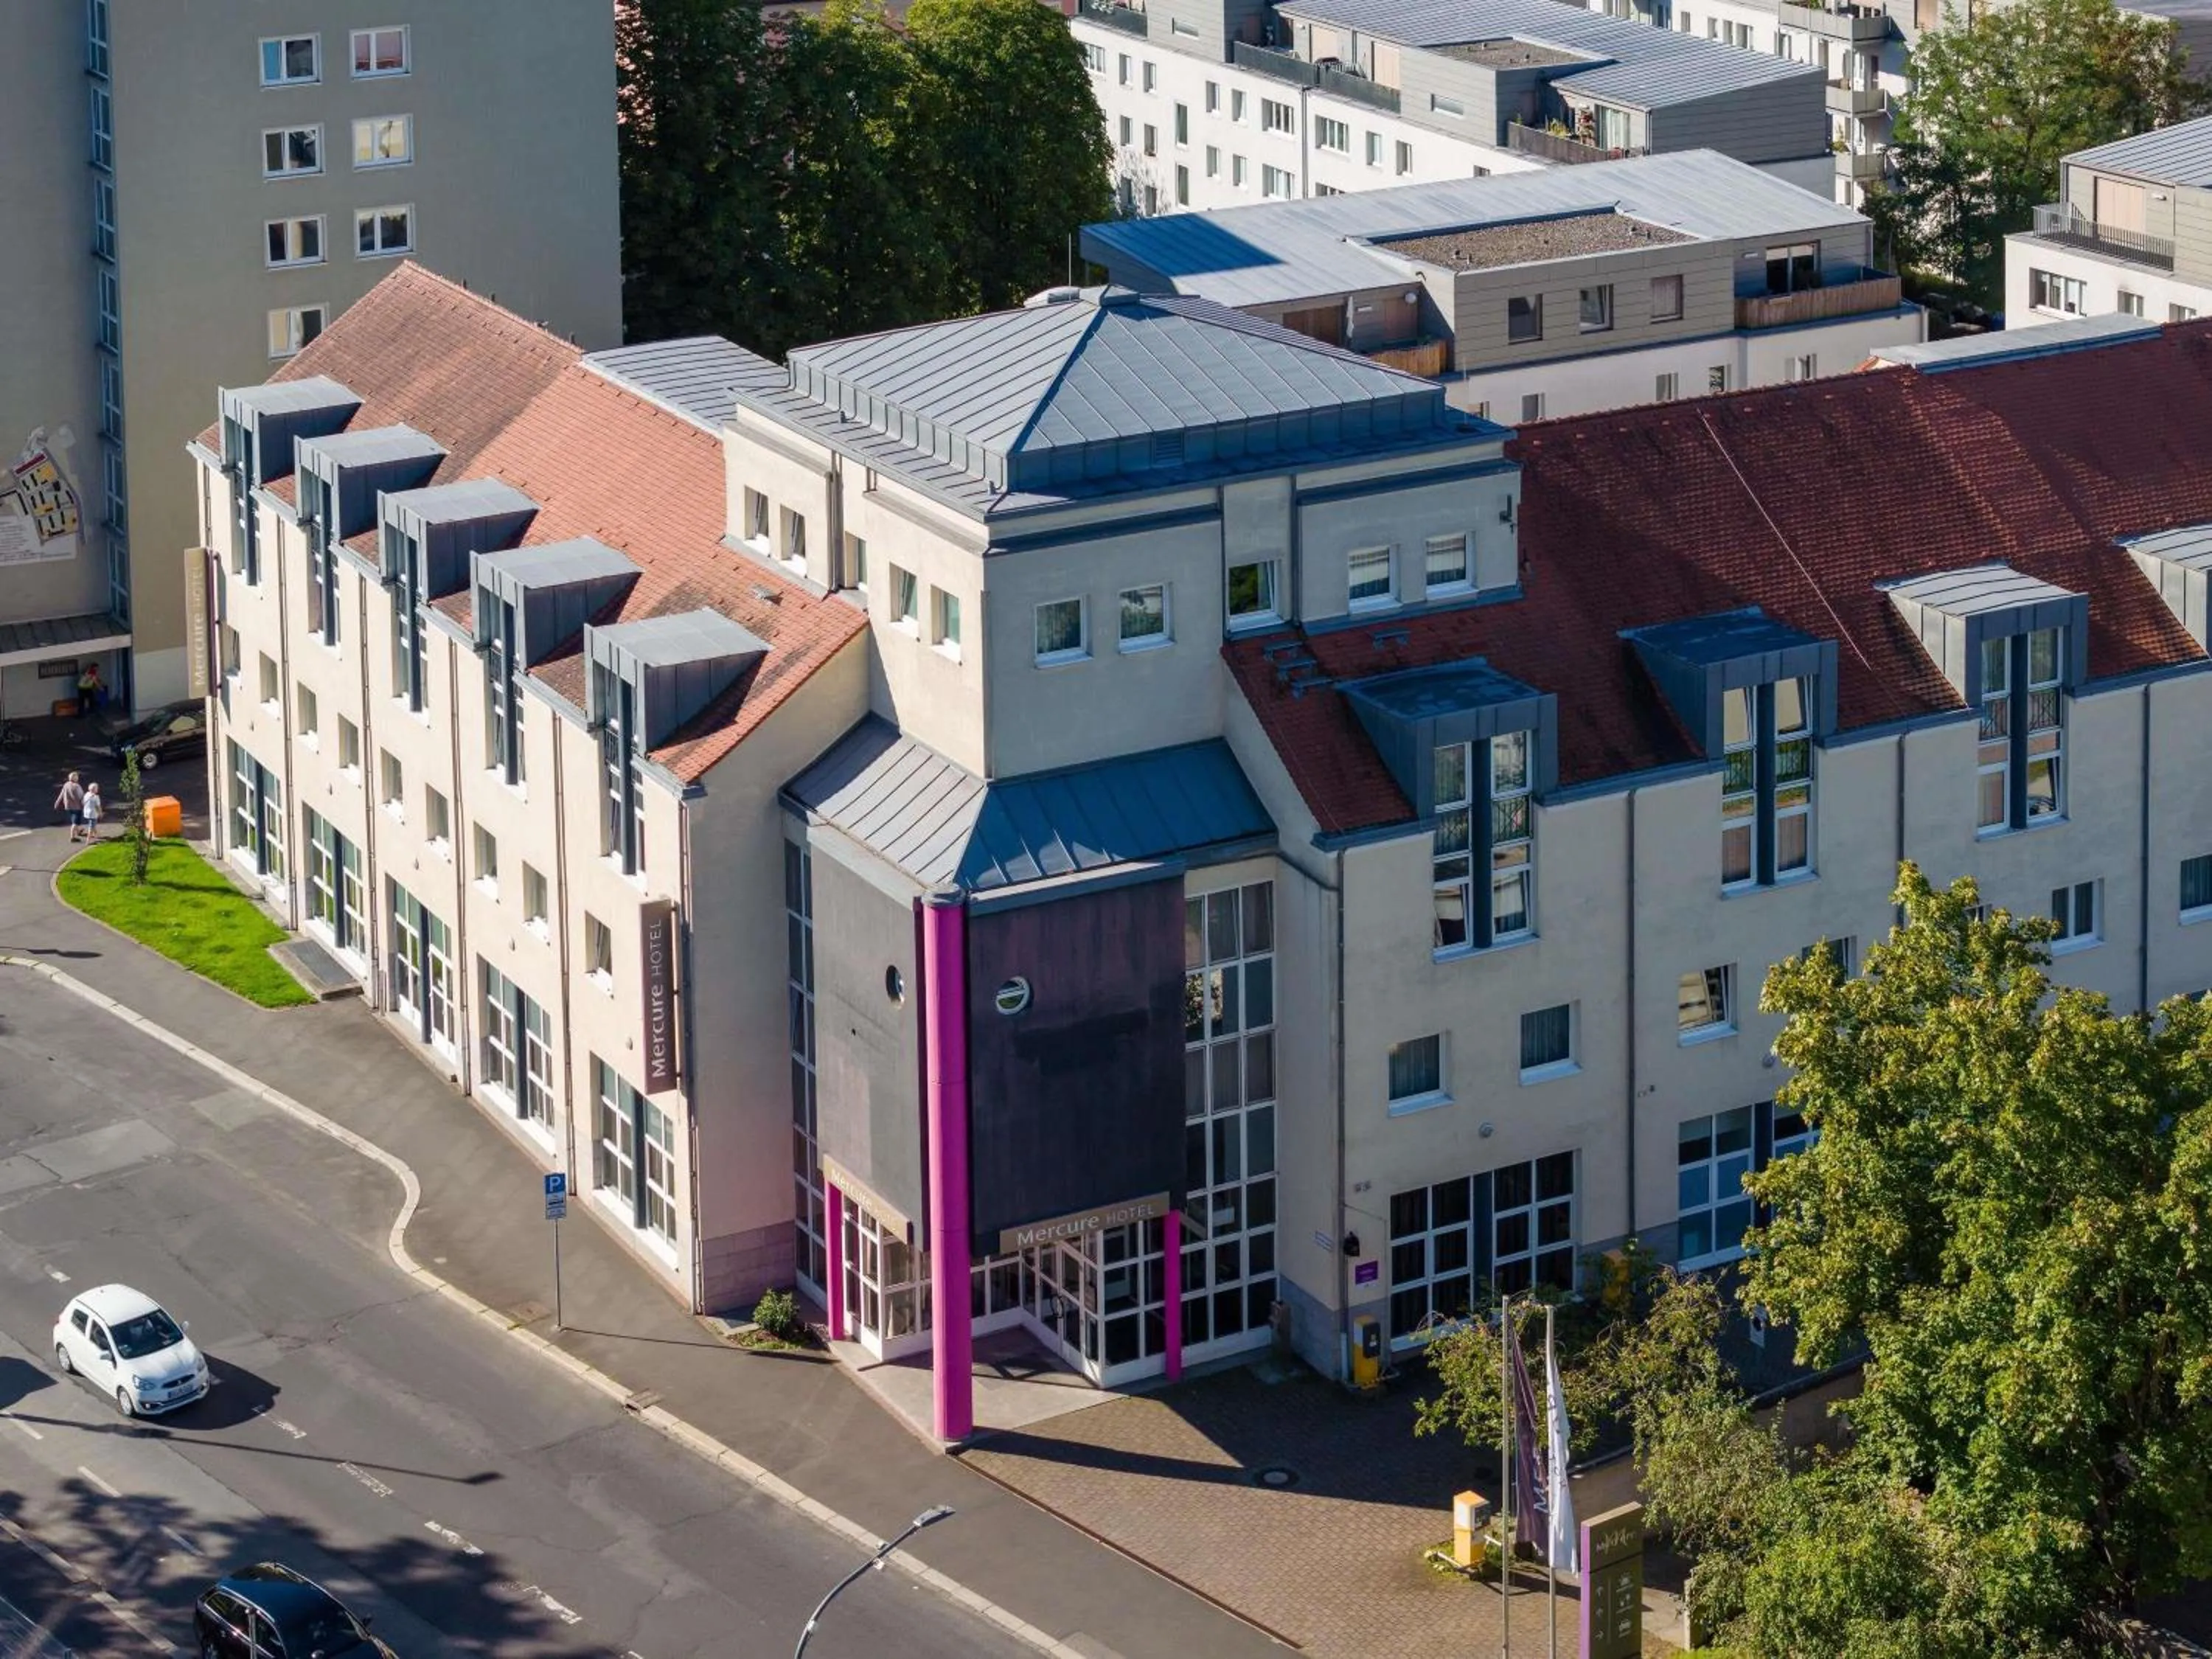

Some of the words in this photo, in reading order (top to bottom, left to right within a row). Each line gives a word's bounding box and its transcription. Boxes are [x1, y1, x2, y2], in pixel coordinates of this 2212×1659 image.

[650, 919, 662, 977] HOTEL
[651, 984, 667, 1078] Mercure
[549, 1176, 561, 1192] P
[1016, 1215, 1099, 1246] Mercure
[1106, 1204, 1154, 1225] HOTEL
